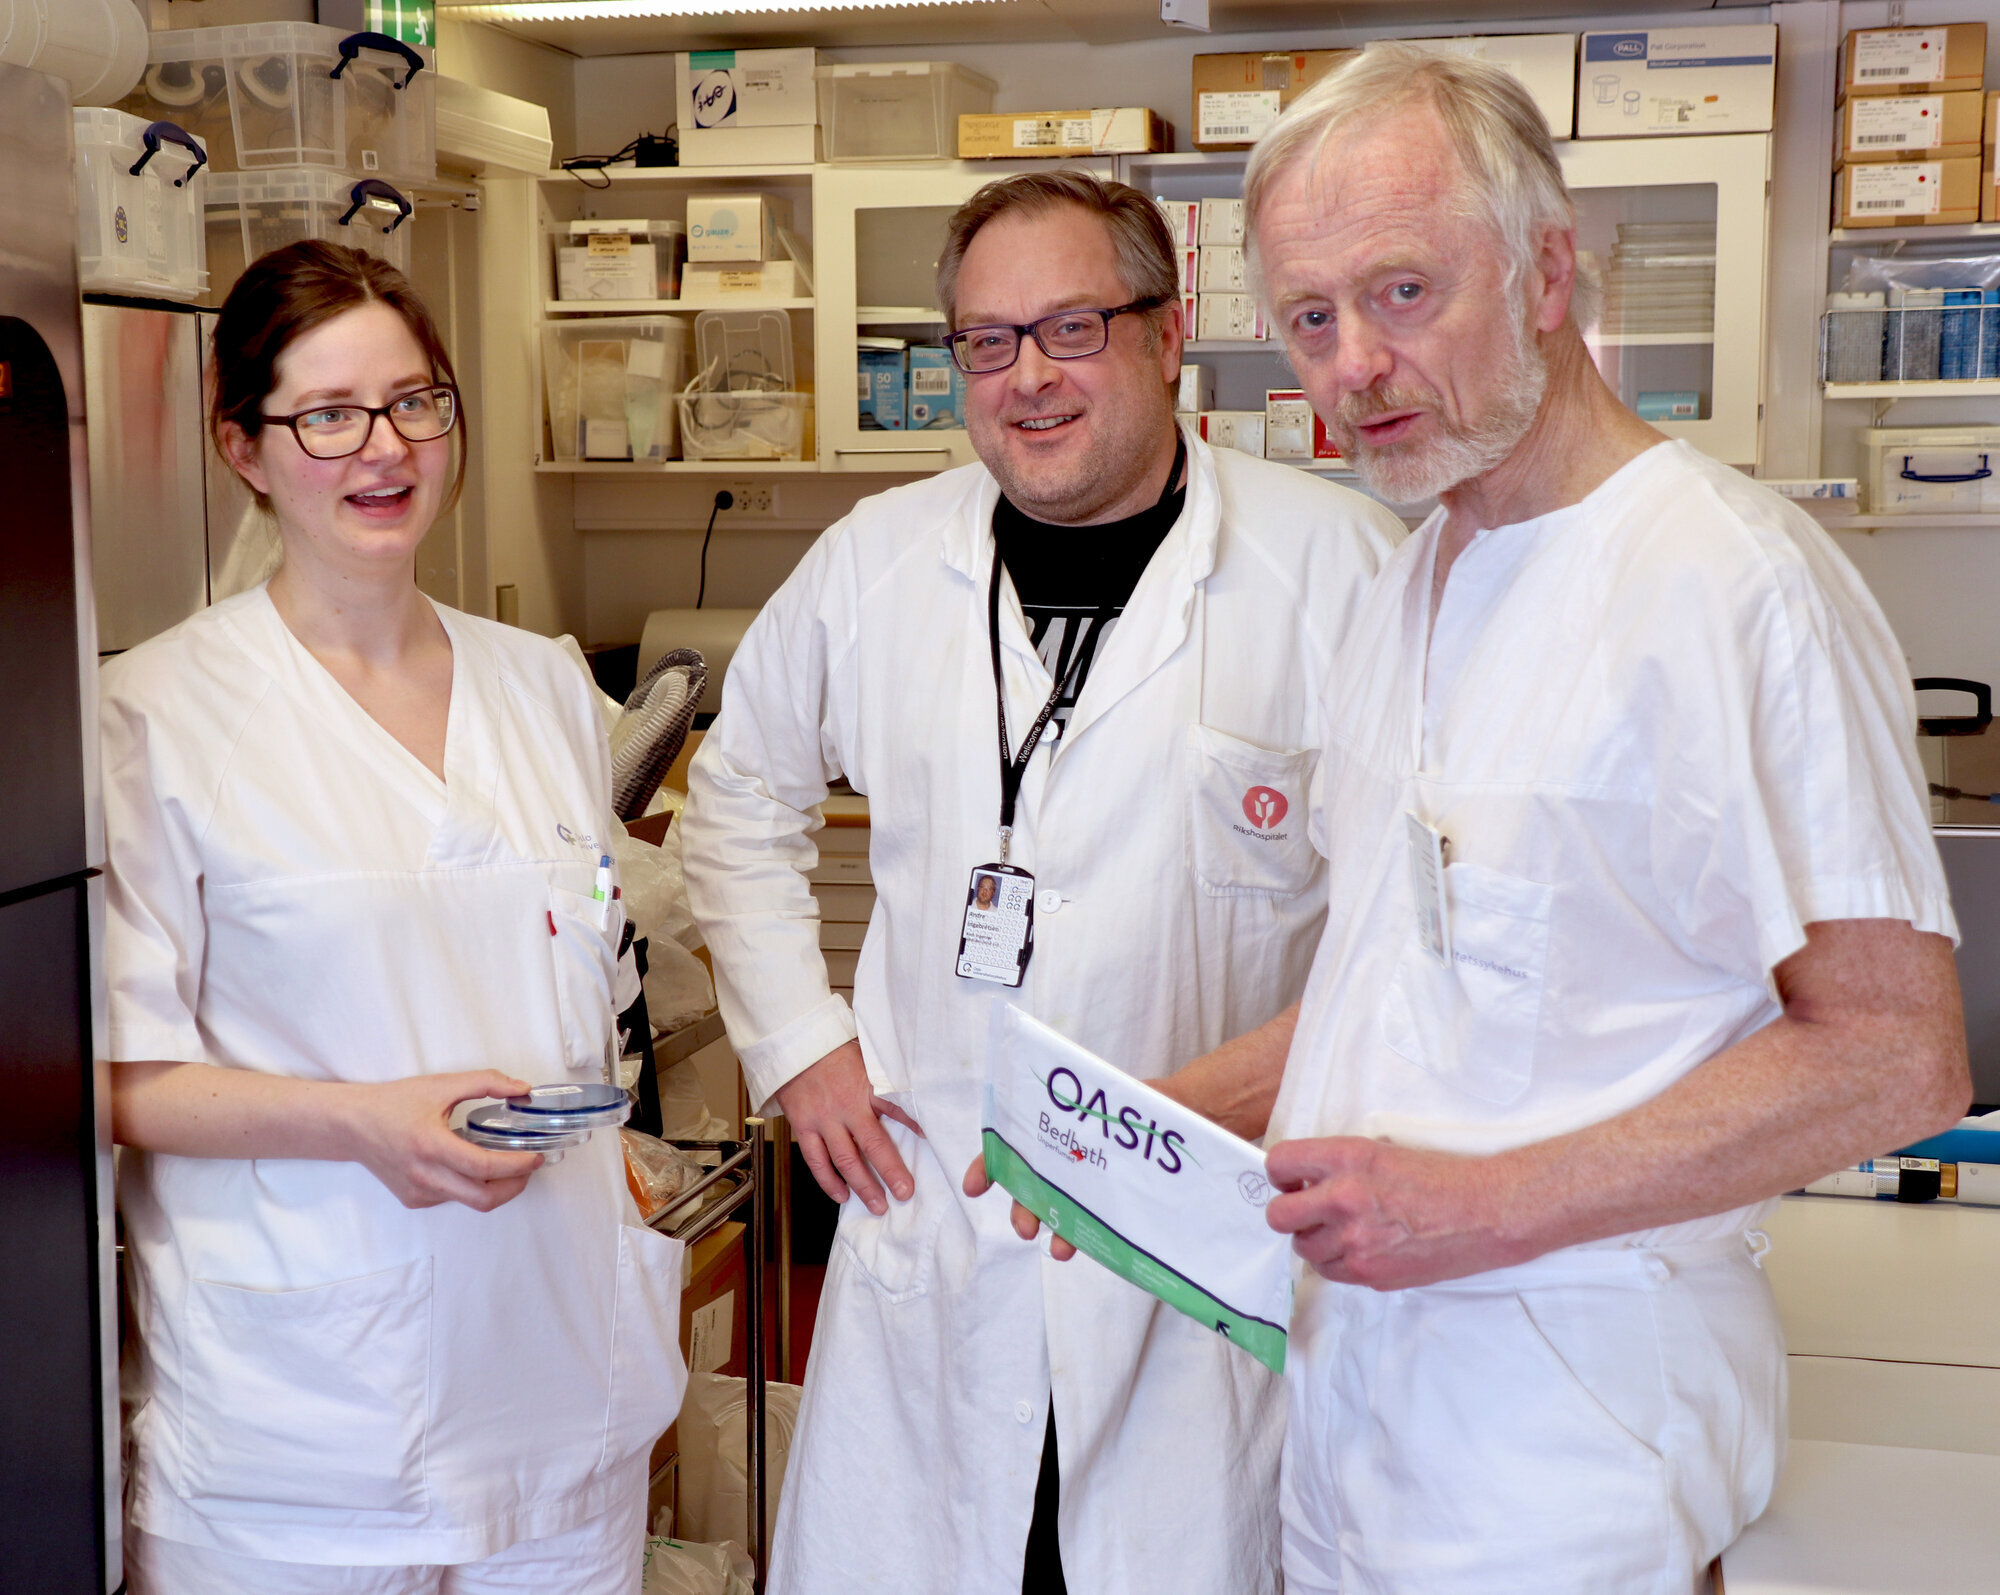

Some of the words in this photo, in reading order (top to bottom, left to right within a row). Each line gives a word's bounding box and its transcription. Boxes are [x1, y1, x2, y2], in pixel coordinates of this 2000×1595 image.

[1617, 43, 1640, 52] PALL
[877, 372, 891, 383] 50
[1019, 725, 1042, 763] Wellcome
[1037, 706, 1051, 723] Trust
[1233, 824, 1288, 842] Rikshospitalet
[1453, 951, 1528, 979] tetssykehus
[1047, 1066, 1186, 1174] OASIS
[1038, 1111, 1107, 1171] Bedbath
[1048, 1207, 1060, 1229] 5
